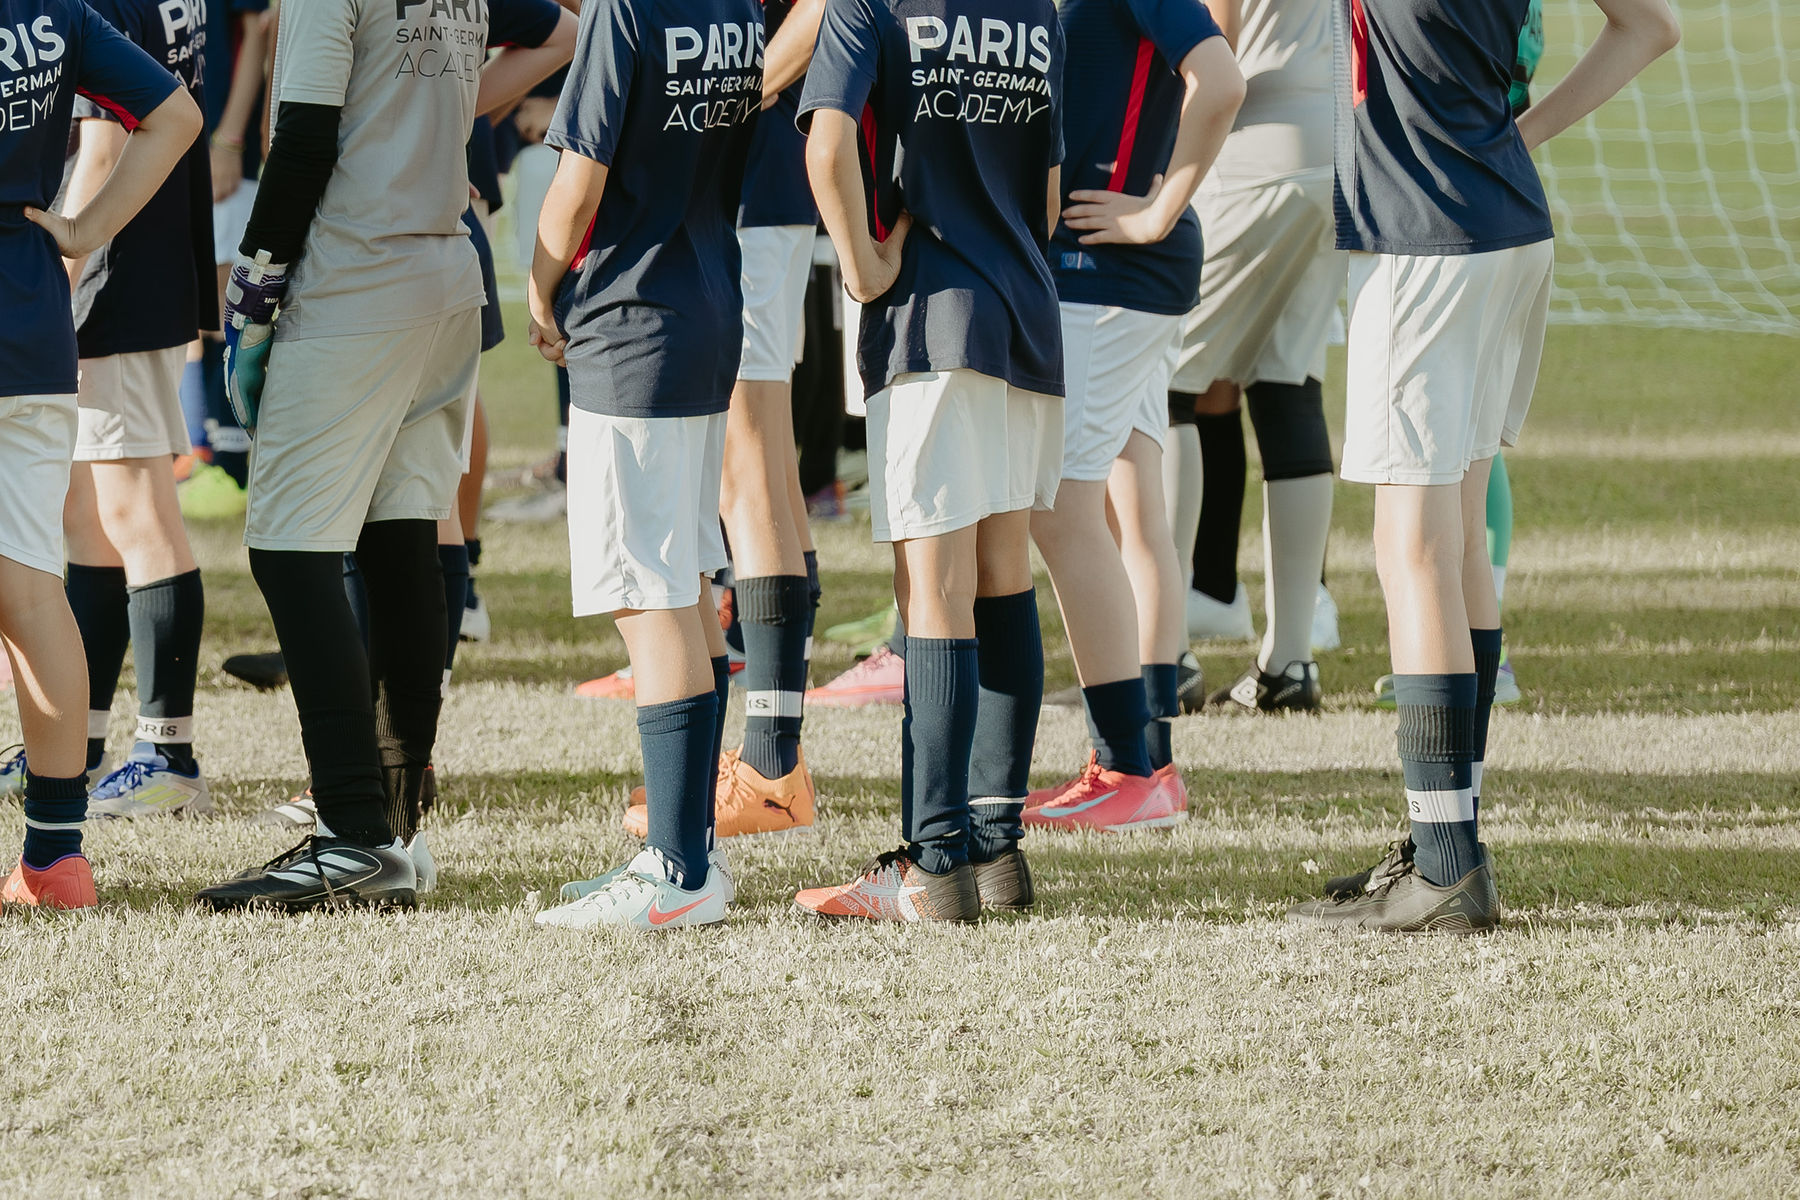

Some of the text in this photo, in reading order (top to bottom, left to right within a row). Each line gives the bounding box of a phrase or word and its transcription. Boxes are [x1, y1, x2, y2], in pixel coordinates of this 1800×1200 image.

[396, 26, 484, 48] SAINT-GERM
[664, 22, 765, 74] PARIS
[906, 15, 1051, 73] PARIS
[140, 723, 178, 737] RIS
